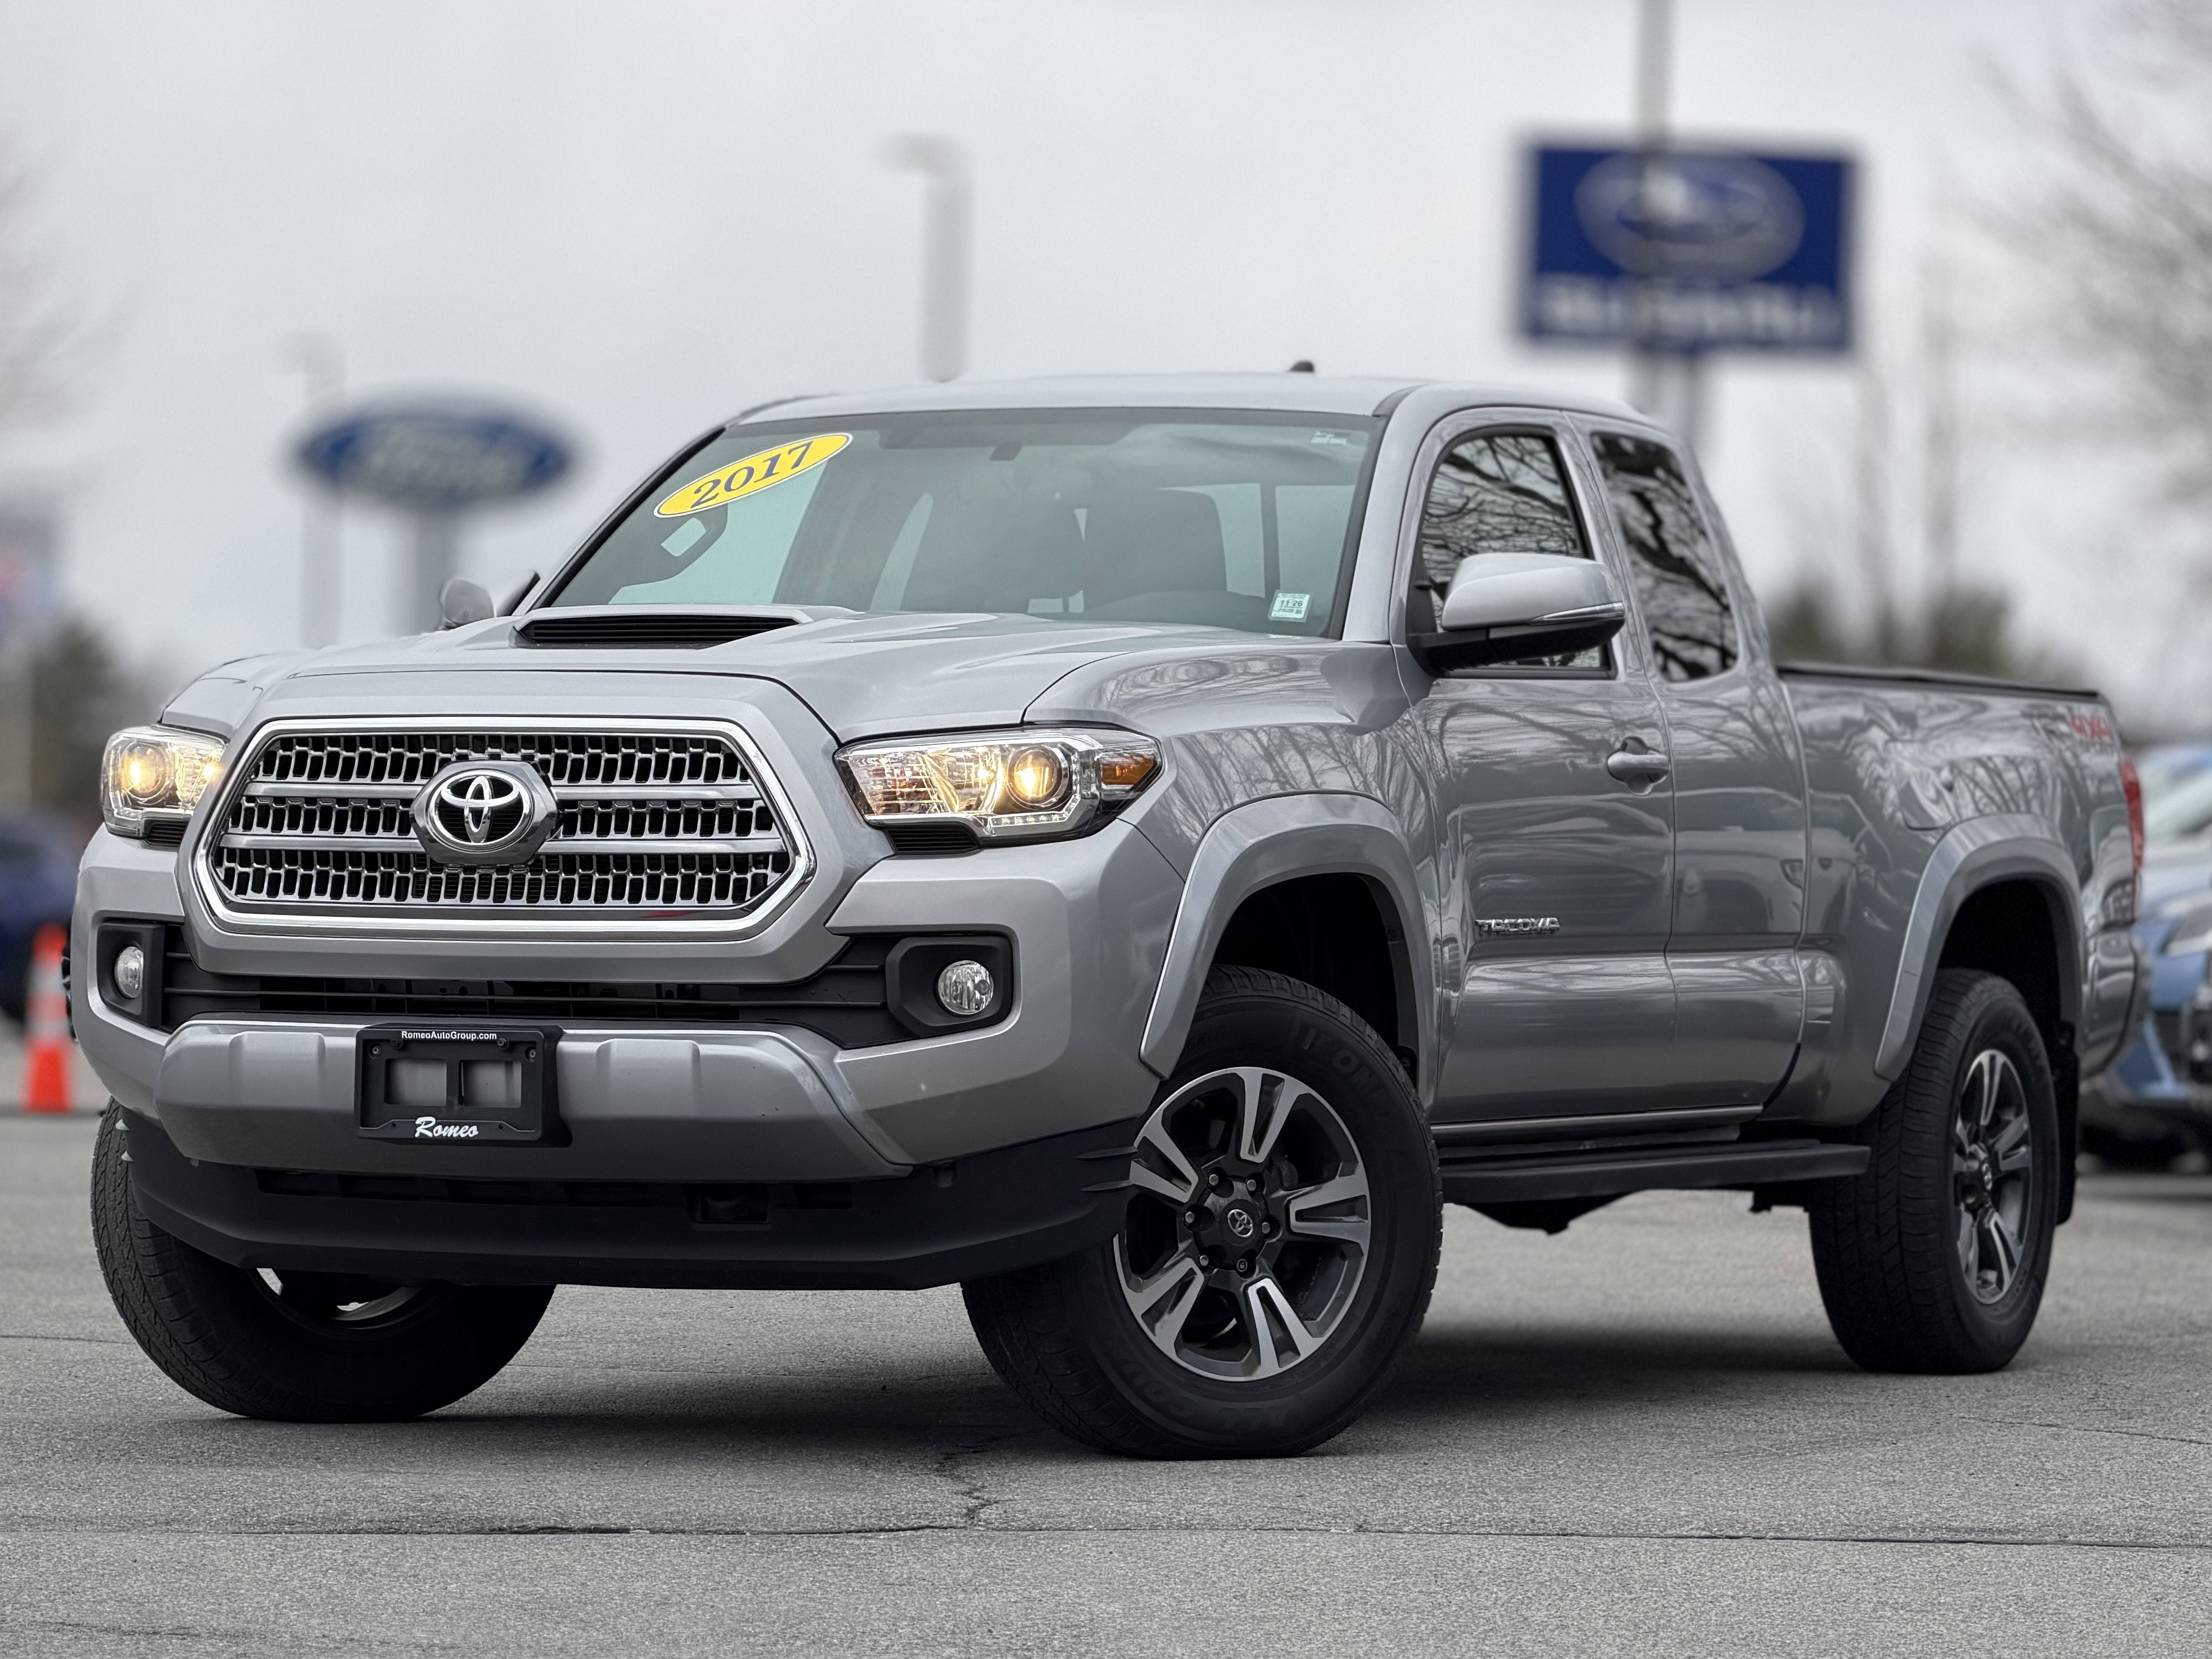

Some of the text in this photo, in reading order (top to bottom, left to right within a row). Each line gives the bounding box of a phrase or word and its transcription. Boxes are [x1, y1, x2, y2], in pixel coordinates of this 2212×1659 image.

[690, 440, 814, 509] 2017
[401, 1031, 497, 1041] RomeoAutoGroup.com
[415, 1116, 479, 1138] Romeo
